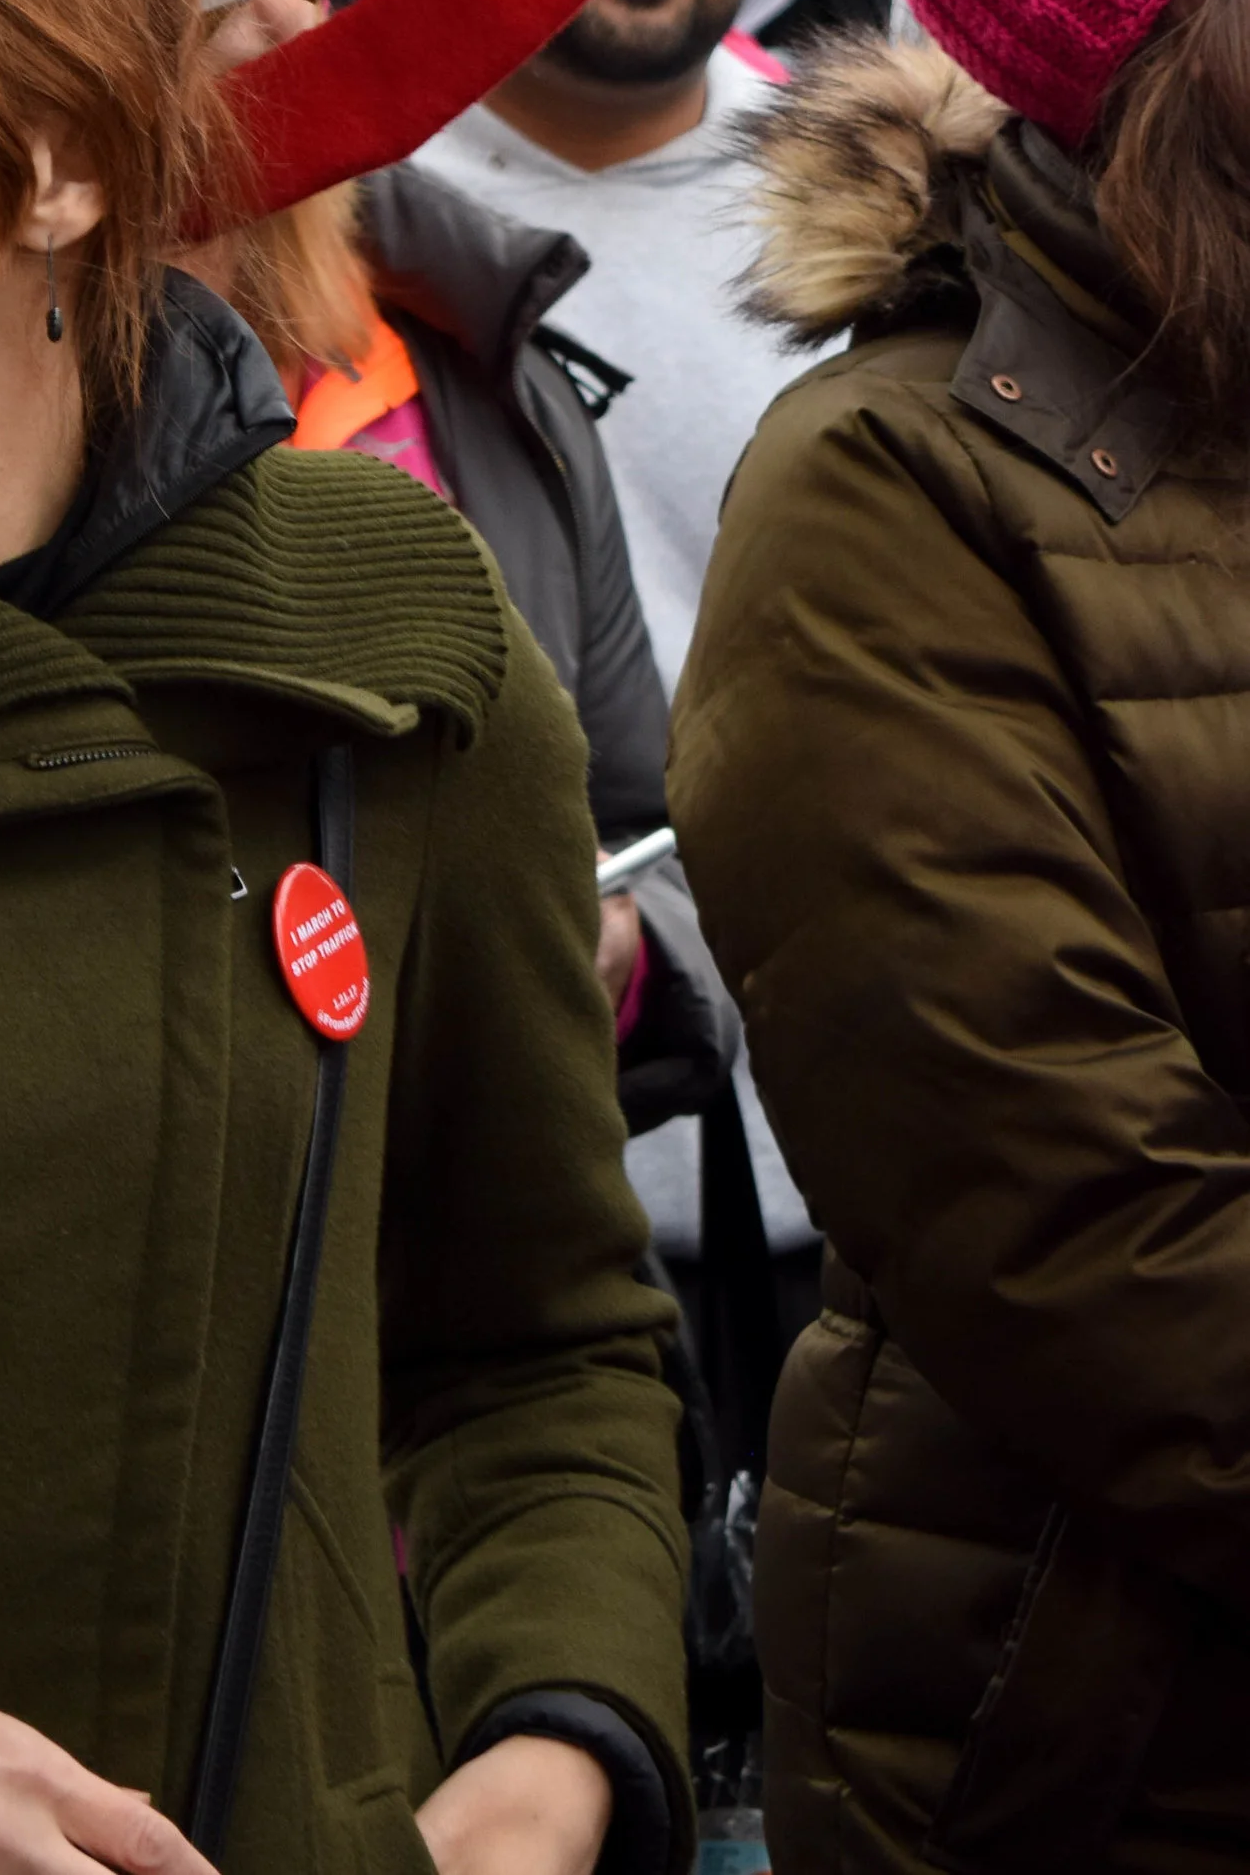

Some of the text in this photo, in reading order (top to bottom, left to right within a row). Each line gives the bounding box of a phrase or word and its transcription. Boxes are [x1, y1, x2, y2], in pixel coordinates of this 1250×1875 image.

[290, 898, 346, 947] I MARCH TO
[291, 921, 359, 978] STOP TRAFFICK
